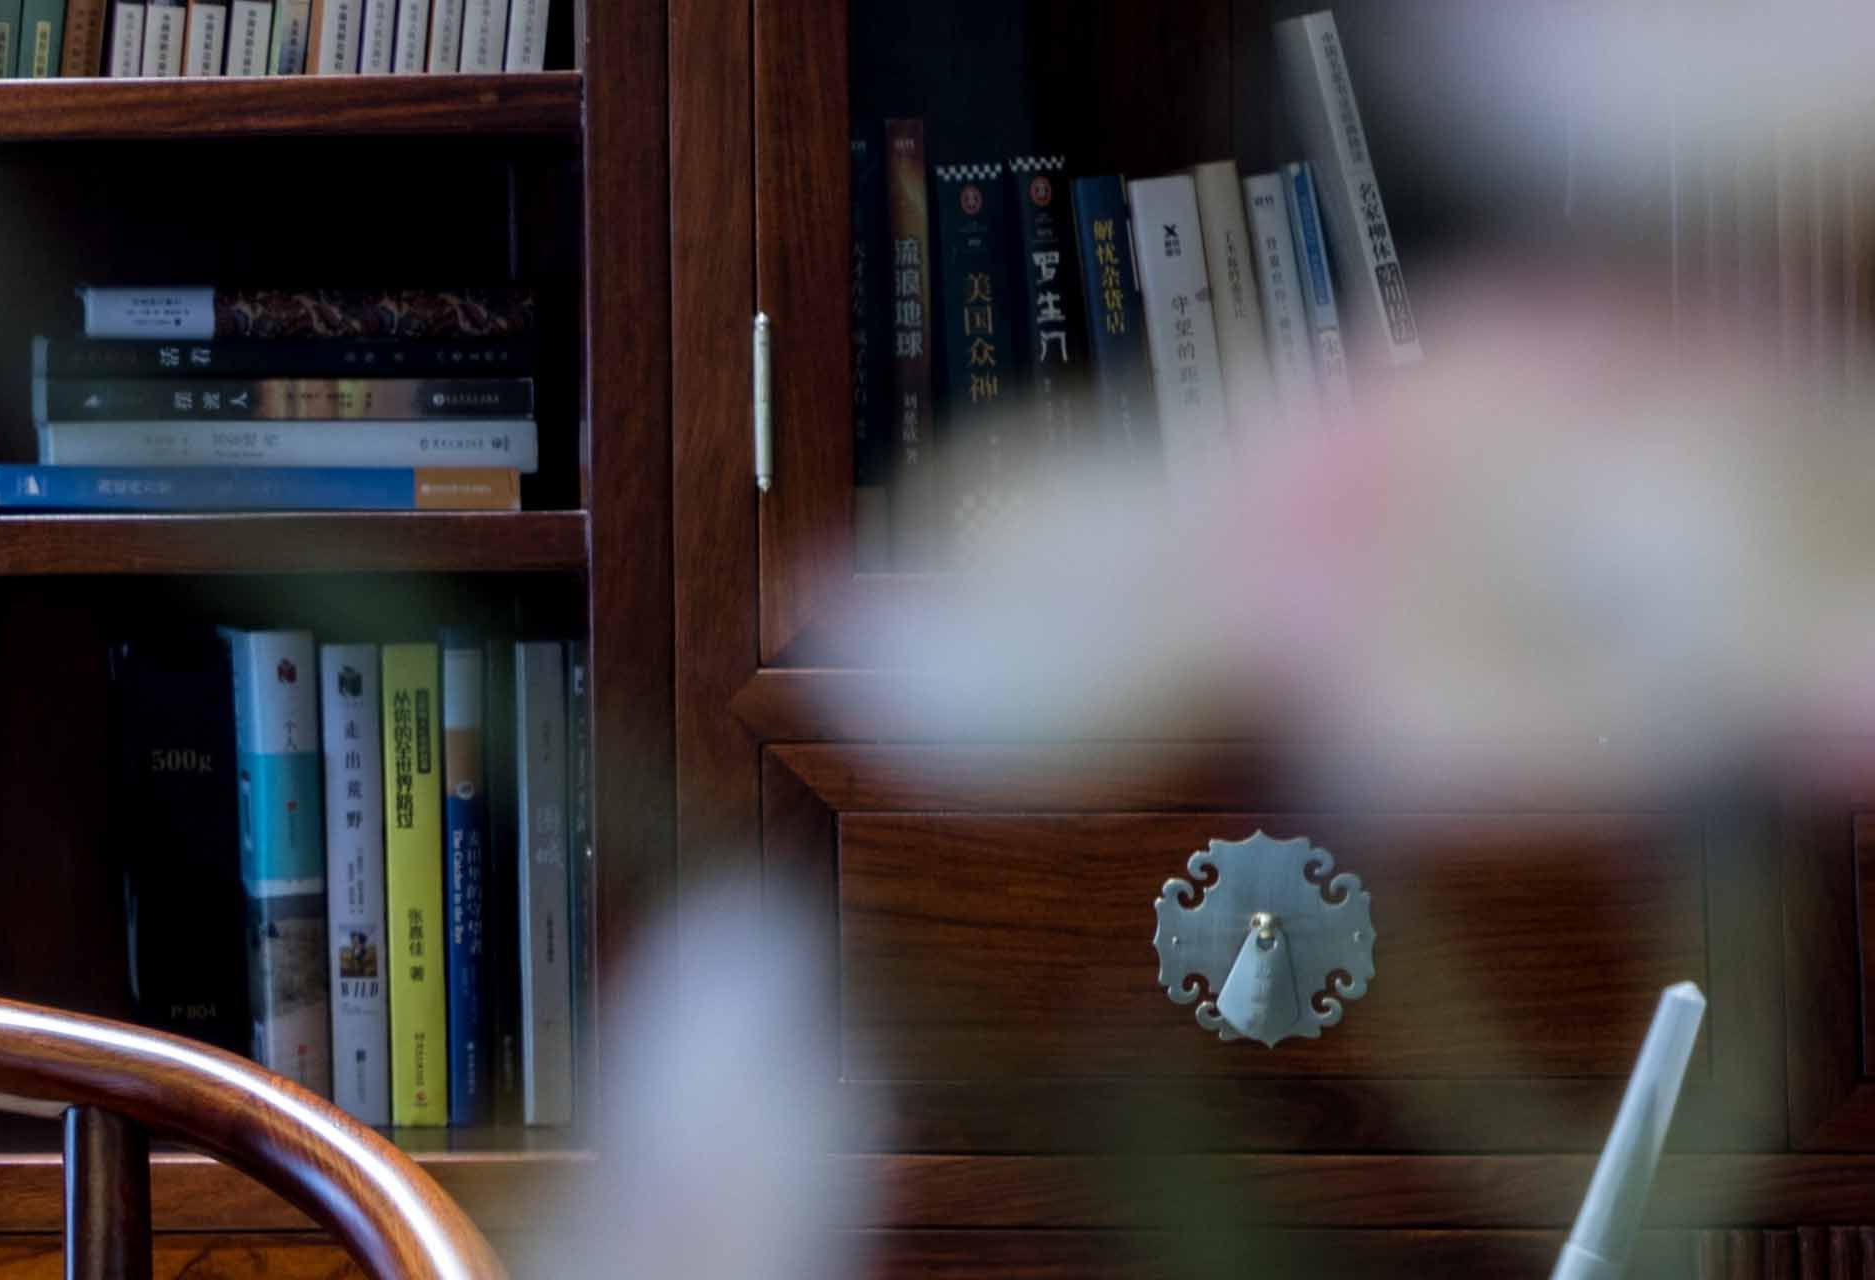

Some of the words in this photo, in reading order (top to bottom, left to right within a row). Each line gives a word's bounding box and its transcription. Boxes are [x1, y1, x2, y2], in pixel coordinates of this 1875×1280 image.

[893, 239, 924, 358] 流浪地球
[1031, 250, 1069, 363] 罗生门
[1092, 219, 1126, 335] 解忧杂货店
[158, 345, 212, 367] 活着
[963, 272, 999, 402] 美国众神
[344, 720, 364, 830] 走出荒野
[393, 689, 414, 829] 从你的全世界路过
